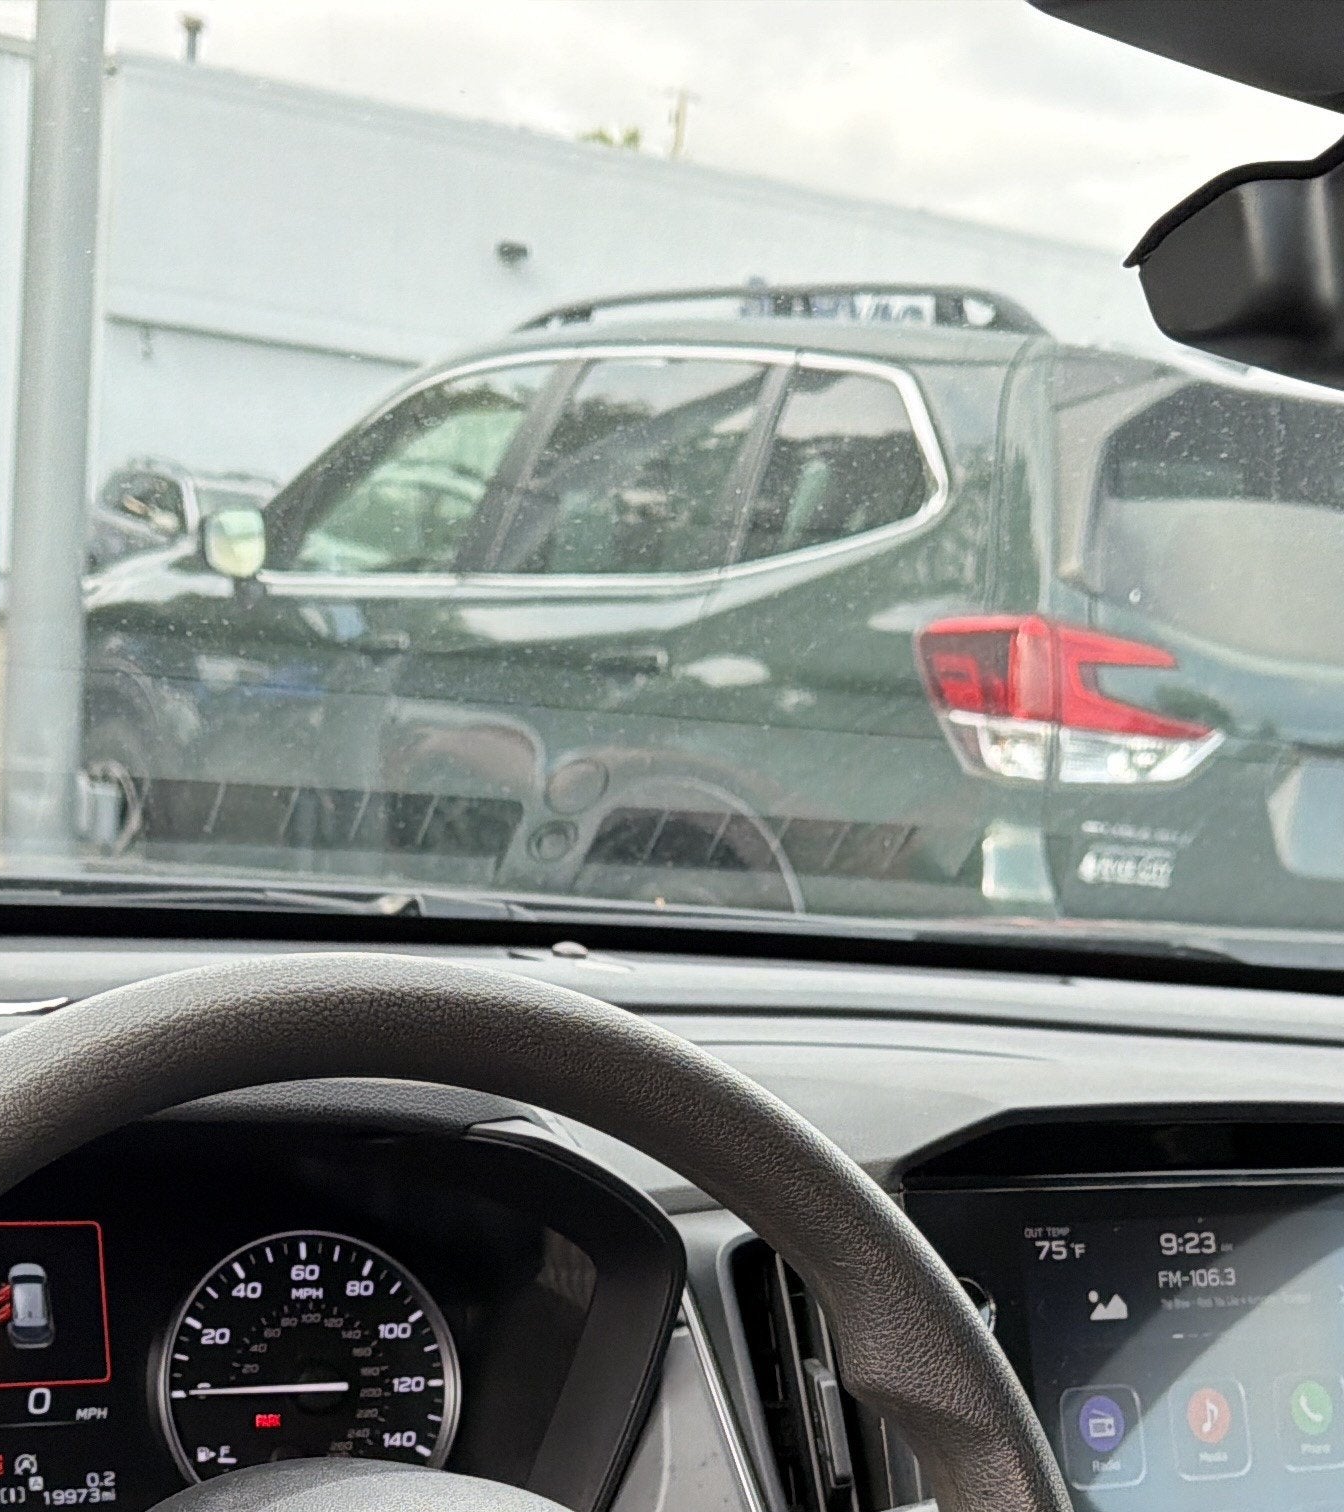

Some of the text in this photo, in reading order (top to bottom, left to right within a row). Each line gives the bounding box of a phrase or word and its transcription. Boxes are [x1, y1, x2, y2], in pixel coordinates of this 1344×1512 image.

[1035, 1240, 1067, 1261] 75
[1159, 1232, 1216, 1255] 9:23
[290, 1265, 321, 1281] 60
[1158, 1268, 1236, 1288] FM-106.3
[231, 1282, 263, 1299] 40
[291, 1288, 324, 1300] MPH
[345, 1280, 375, 1297] 80
[200, 1328, 231, 1345] 20
[378, 1322, 412, 1339] 100
[392, 1376, 426, 1393] 120
[28, 1388, 51, 1414] 0
[76, 1407, 108, 1420] MPH
[383, 1431, 417, 1448] 140
[86, 1471, 116, 1488] 0.2
